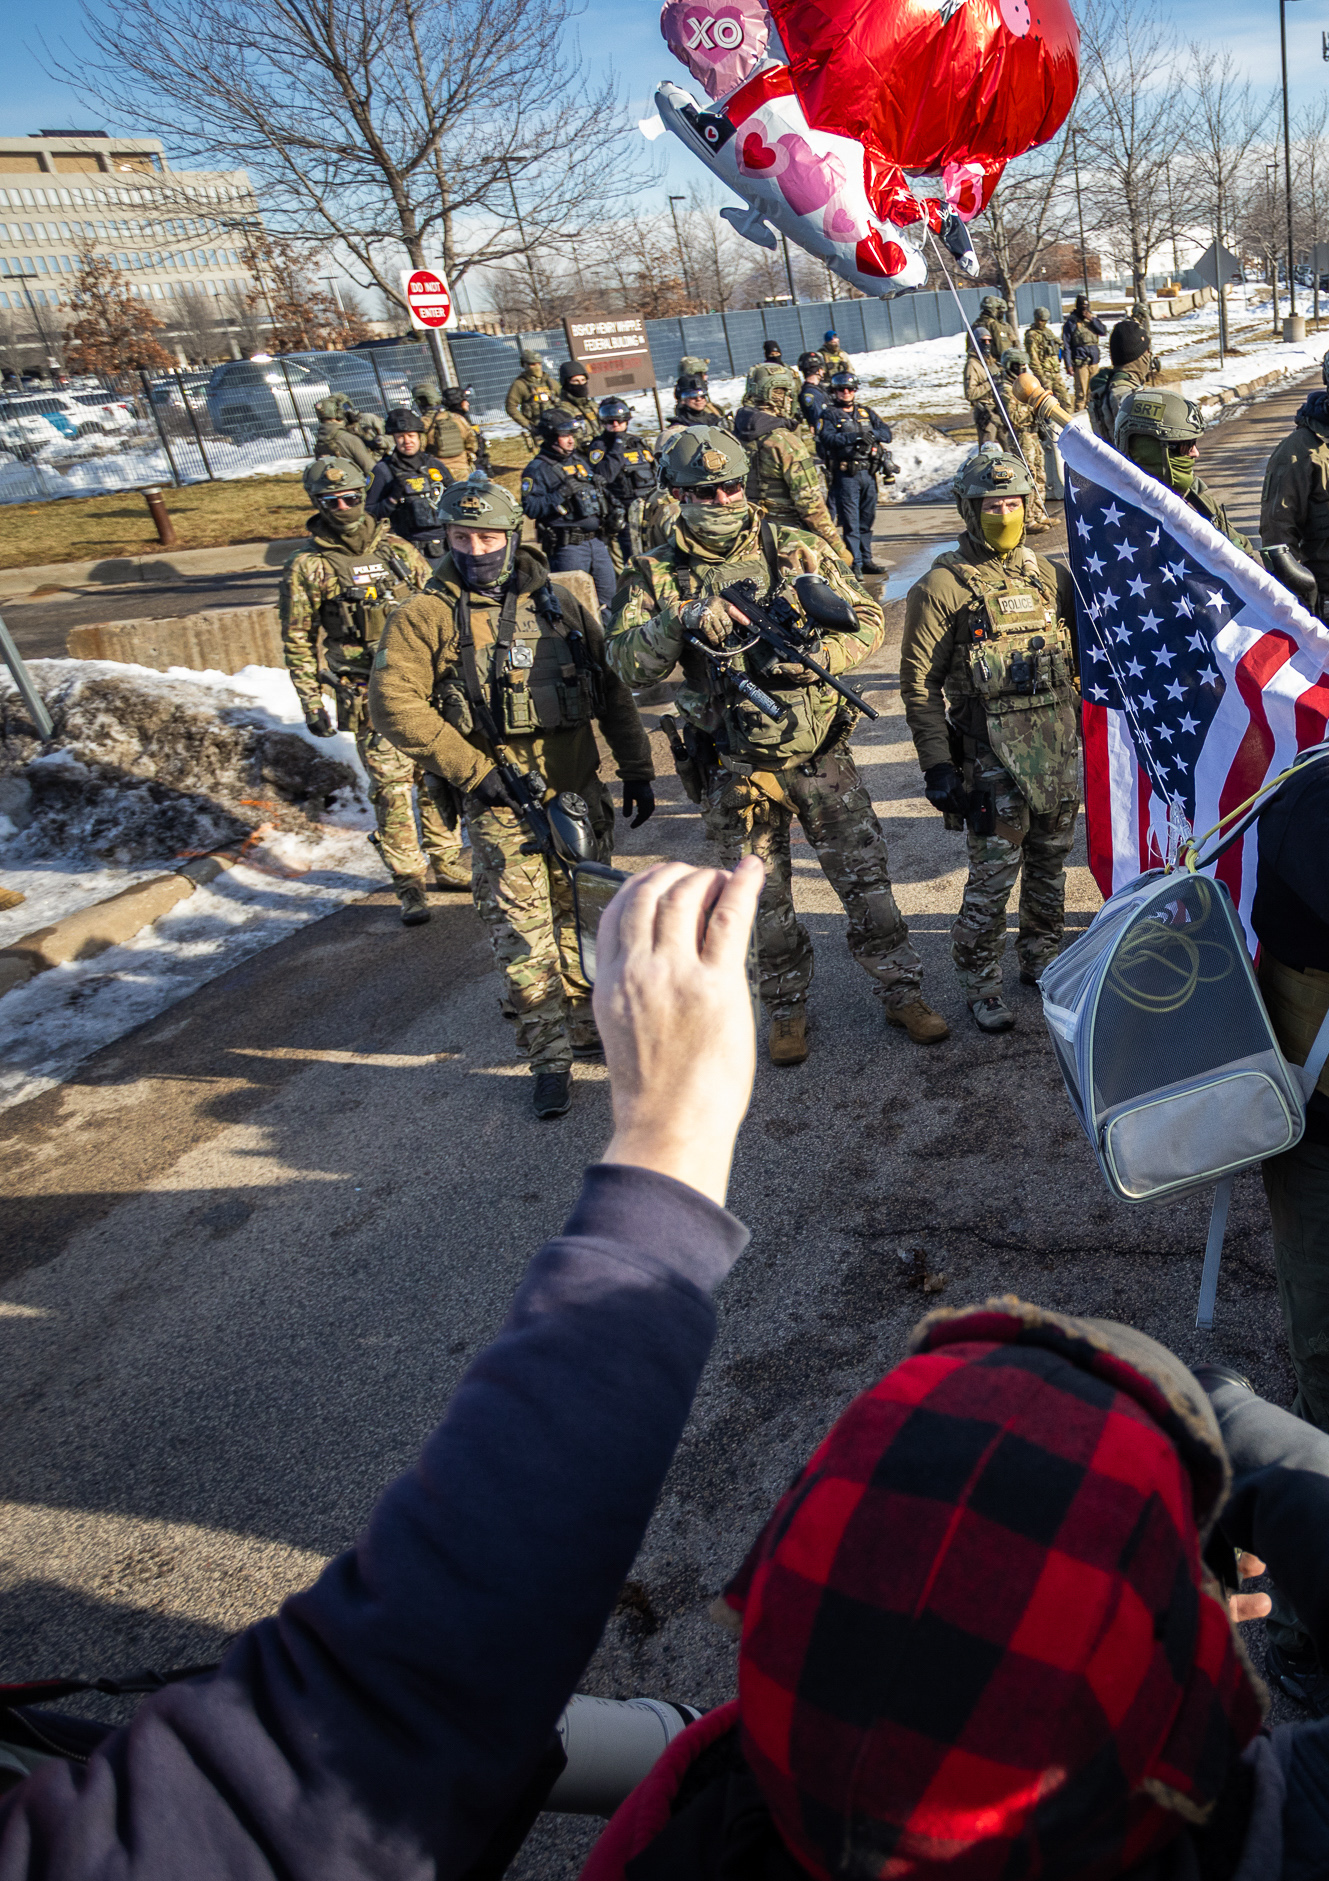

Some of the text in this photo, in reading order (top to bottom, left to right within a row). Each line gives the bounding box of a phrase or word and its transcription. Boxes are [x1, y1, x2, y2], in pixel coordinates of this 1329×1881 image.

[686, 15, 744, 50] XO
[410, 281, 441, 293] DO NOT
[418, 306, 446, 318] ENTER
[571, 319, 643, 336] BISHOP HENRY WHIPPLE
[583, 337, 612, 351] FEDERAL
[611, 335, 640, 348] BUILDING
[1134, 403, 1161, 416] SRT
[353, 563, 385, 575] POLICE
[1001, 598, 1033, 611] POLICE
